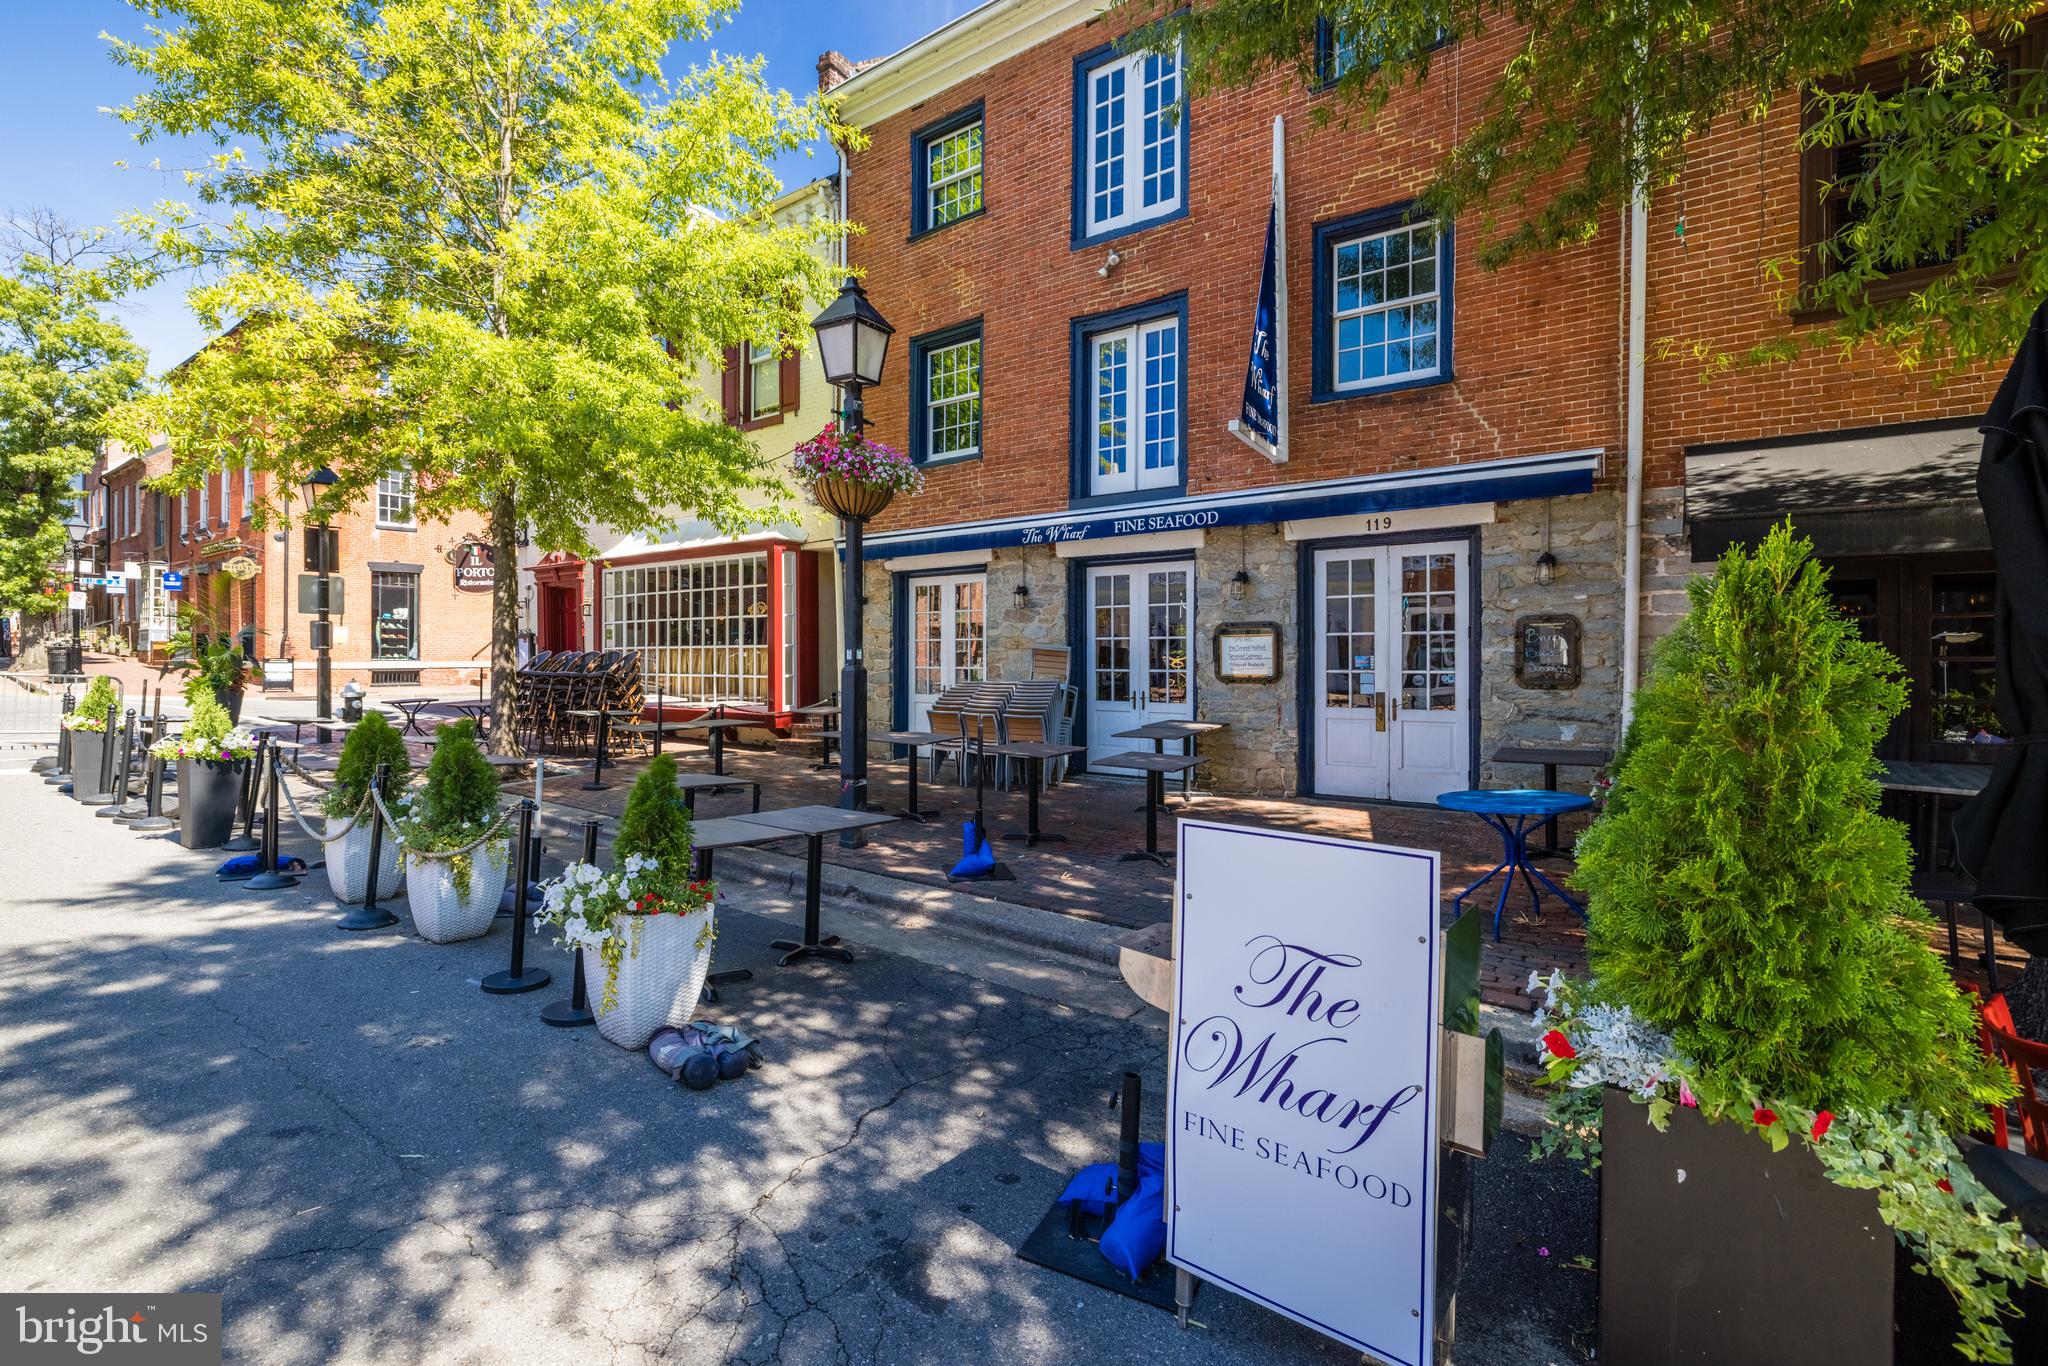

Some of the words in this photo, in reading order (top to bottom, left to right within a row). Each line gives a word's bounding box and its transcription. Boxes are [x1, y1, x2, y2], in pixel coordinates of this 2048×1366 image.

[1253, 330, 1270, 361] The
[1250, 362, 1276, 409] Wharf
[1245, 402, 1257, 422] FINE
[1022, 527, 1043, 544] The
[1045, 524, 1091, 542] Wharf
[1113, 518, 1146, 534] FINE
[1148, 511, 1219, 530] SEAFOOD
[1366, 516, 1392, 531] 119
[470, 556, 482, 566] IL
[1233, 934, 1363, 1029] The
[1184, 1015, 1424, 1154] Wharf
[1183, 1111, 1245, 1151] FINE
[1255, 1136, 1412, 1209] SEAFOOD
